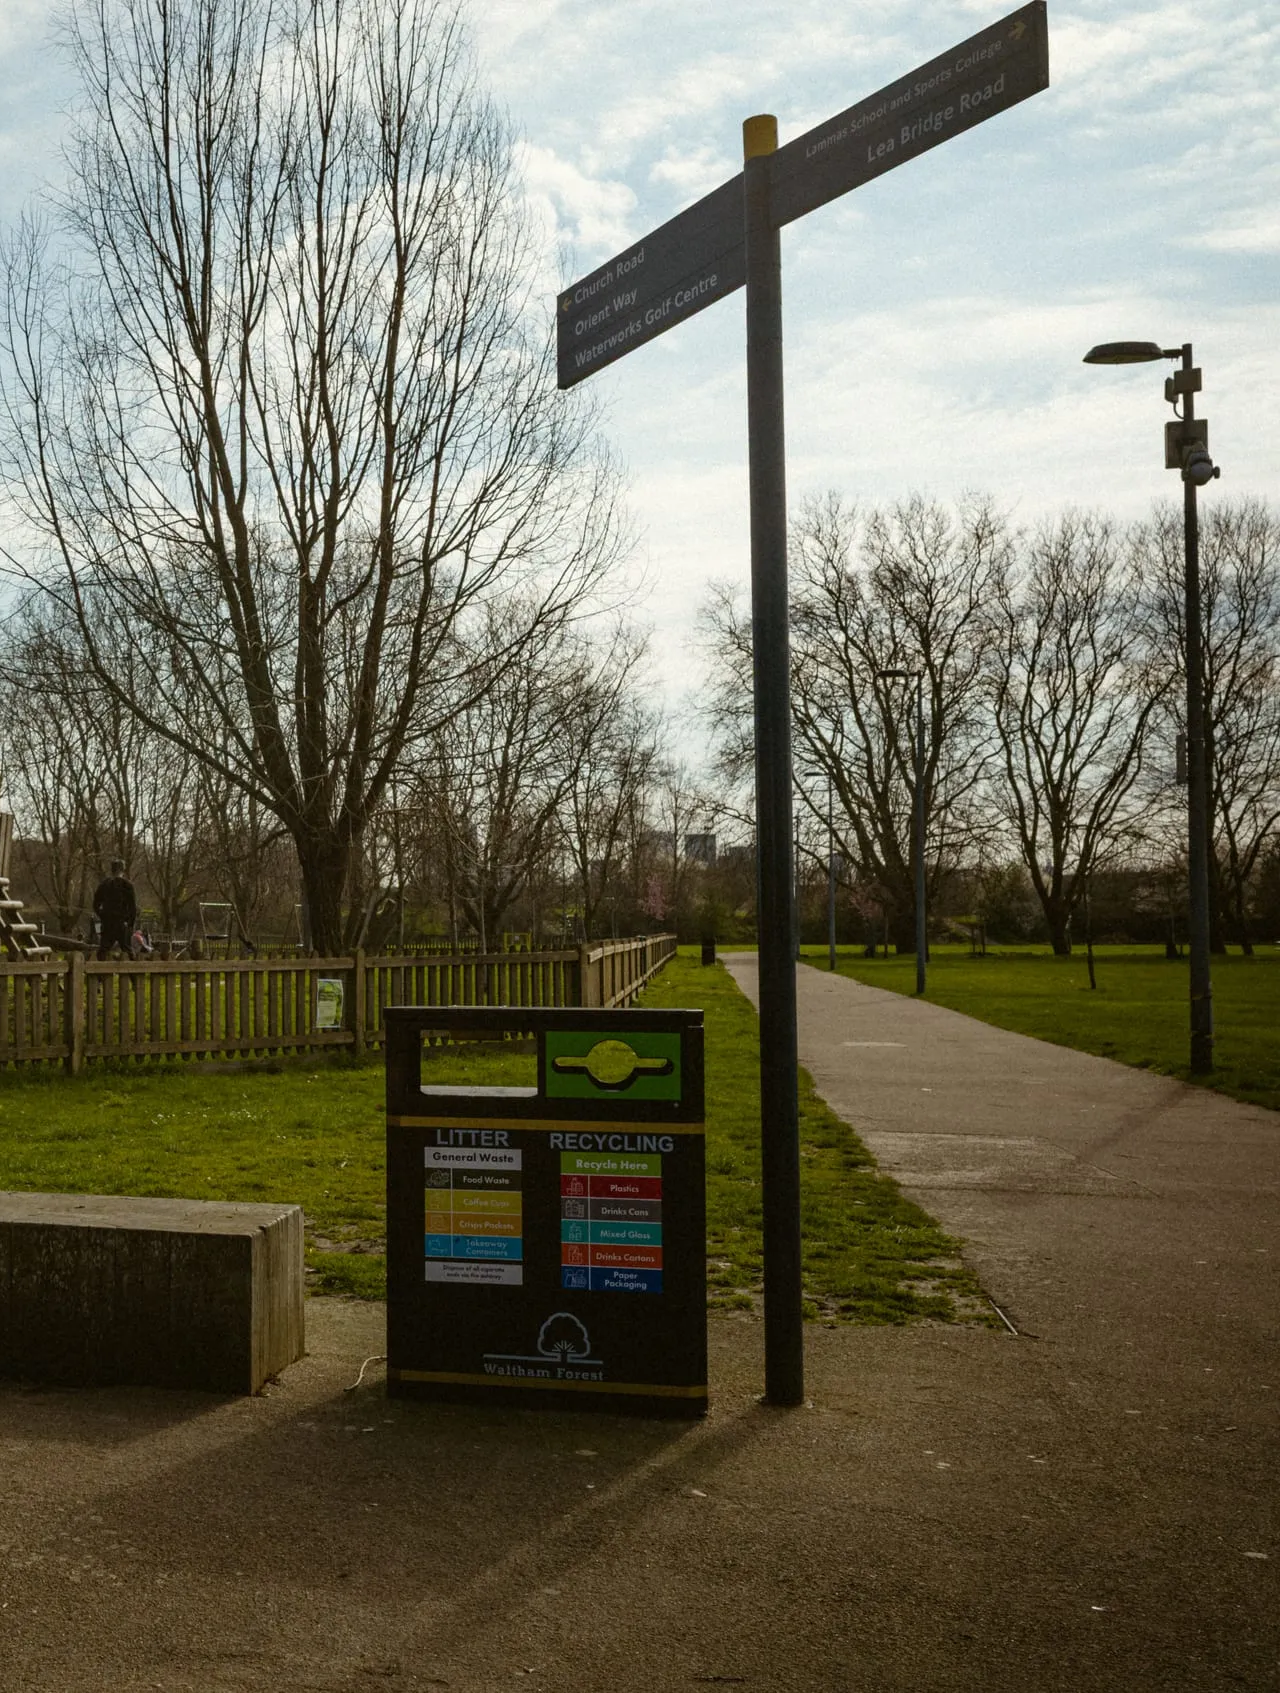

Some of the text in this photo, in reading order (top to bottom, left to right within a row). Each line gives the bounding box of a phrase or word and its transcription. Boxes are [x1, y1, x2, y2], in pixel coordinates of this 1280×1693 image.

[806, 39, 1003, 159] Lammas School and Sports College
[867, 74, 1005, 163] Lea Bridge Road
[574, 248, 645, 304] Church Road
[575, 288, 638, 336] Orient Way
[575, 273, 718, 368] Waterworks Golf Centre
[436, 1128, 509, 1147] LITTER
[549, 1133, 674, 1152] RECYCLING
[432, 1151, 514, 1164] General Waste
[575, 1159, 649, 1172] Recycle Here
[462, 1175, 510, 1185] Food Waste
[609, 1184, 640, 1194] Plastics
[463, 1198, 488, 1207] Coffee
[601, 1206, 649, 1217] Drinks Cans
[459, 1219, 515, 1231] Crisps Packets
[600, 1229, 651, 1240] Mixed Glass
[465, 1238, 508, 1249] Takeaway
[465, 1247, 508, 1257] Containers
[595, 1251, 655, 1263] Drinks Cartons
[613, 1271, 638, 1281] Paper
[604, 1279, 648, 1290] Packaging
[483, 1363, 604, 1381] Waltham Forest
